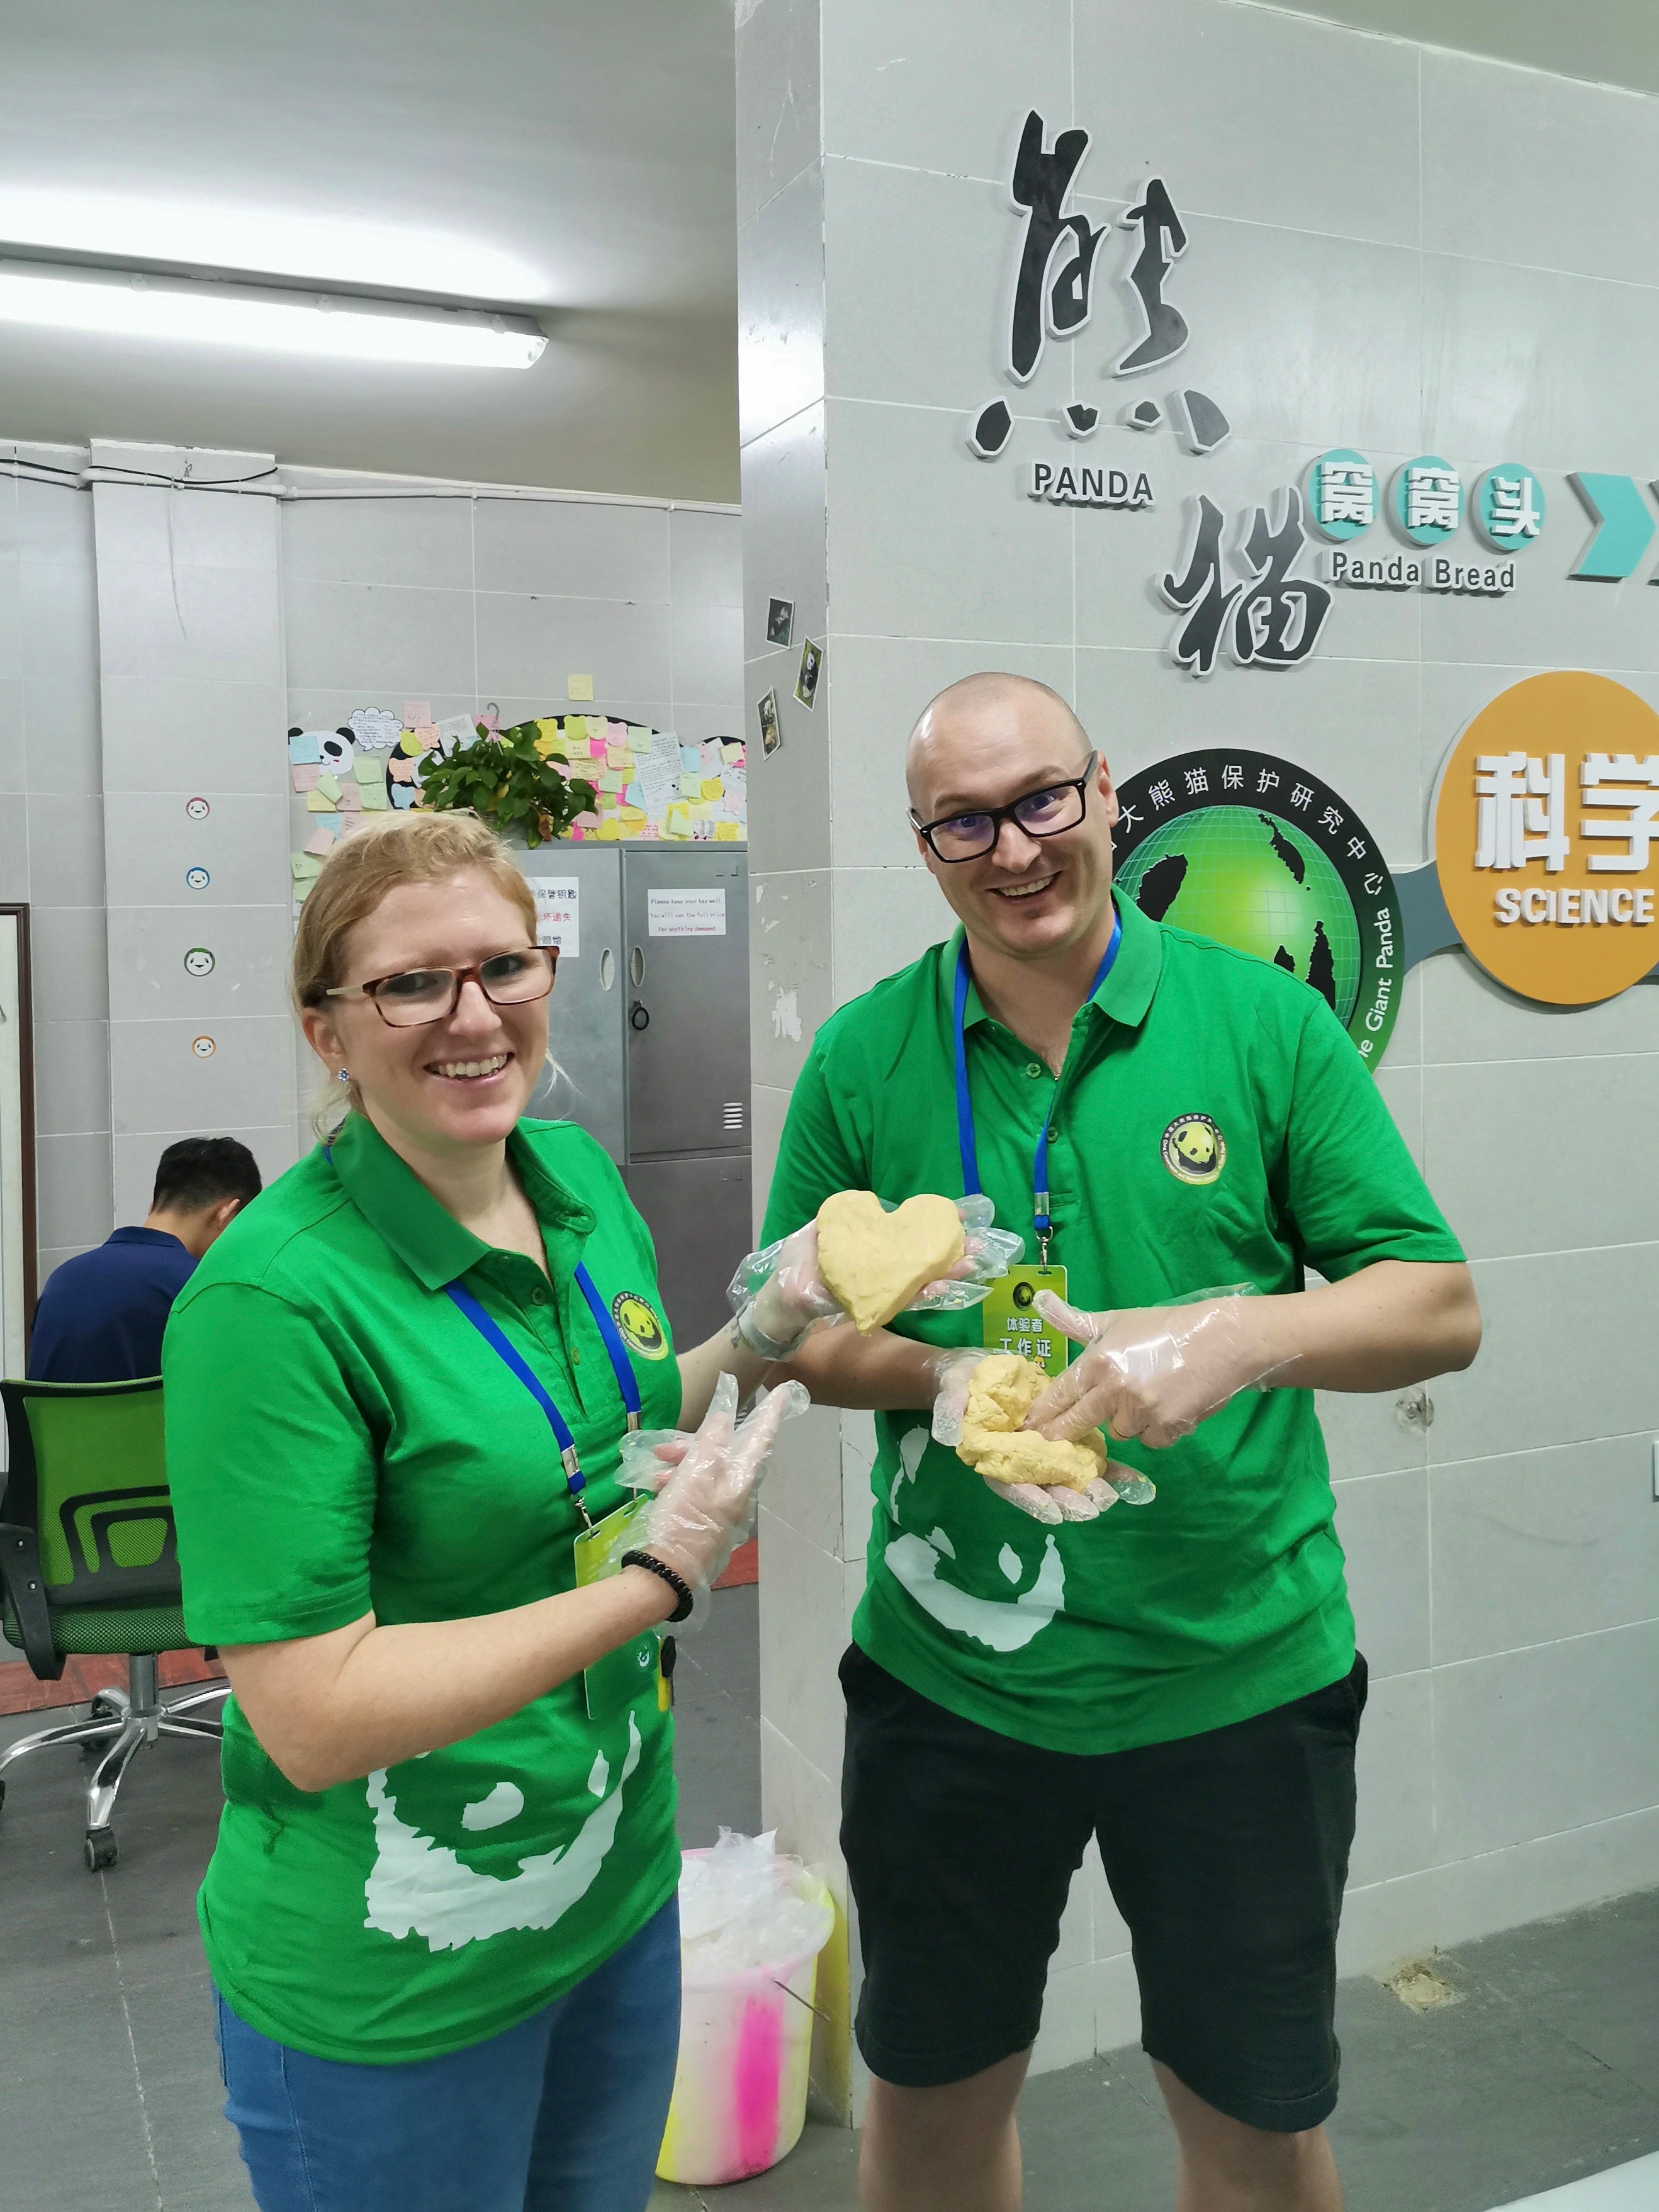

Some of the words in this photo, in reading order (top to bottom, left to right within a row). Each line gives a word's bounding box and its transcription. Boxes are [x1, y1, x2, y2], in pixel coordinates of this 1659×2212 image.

[1034, 463, 1154, 502] PANDA
[1319, 461, 1540, 537] 窝窝头
[1332, 551, 1419, 582] Panda
[1435, 558, 1514, 588] Bread
[1110, 764, 1384, 895] 大熊猫保护研究中心
[1475, 751, 1659, 871] 科学
[1494, 888, 1655, 924] SCIENCE
[1373, 906, 1393, 968] Panda
[1365, 977, 1392, 1031] Giant
[999, 1337, 1052, 1358] 工作证
[1006, 1317, 1043, 1333] 体验者
